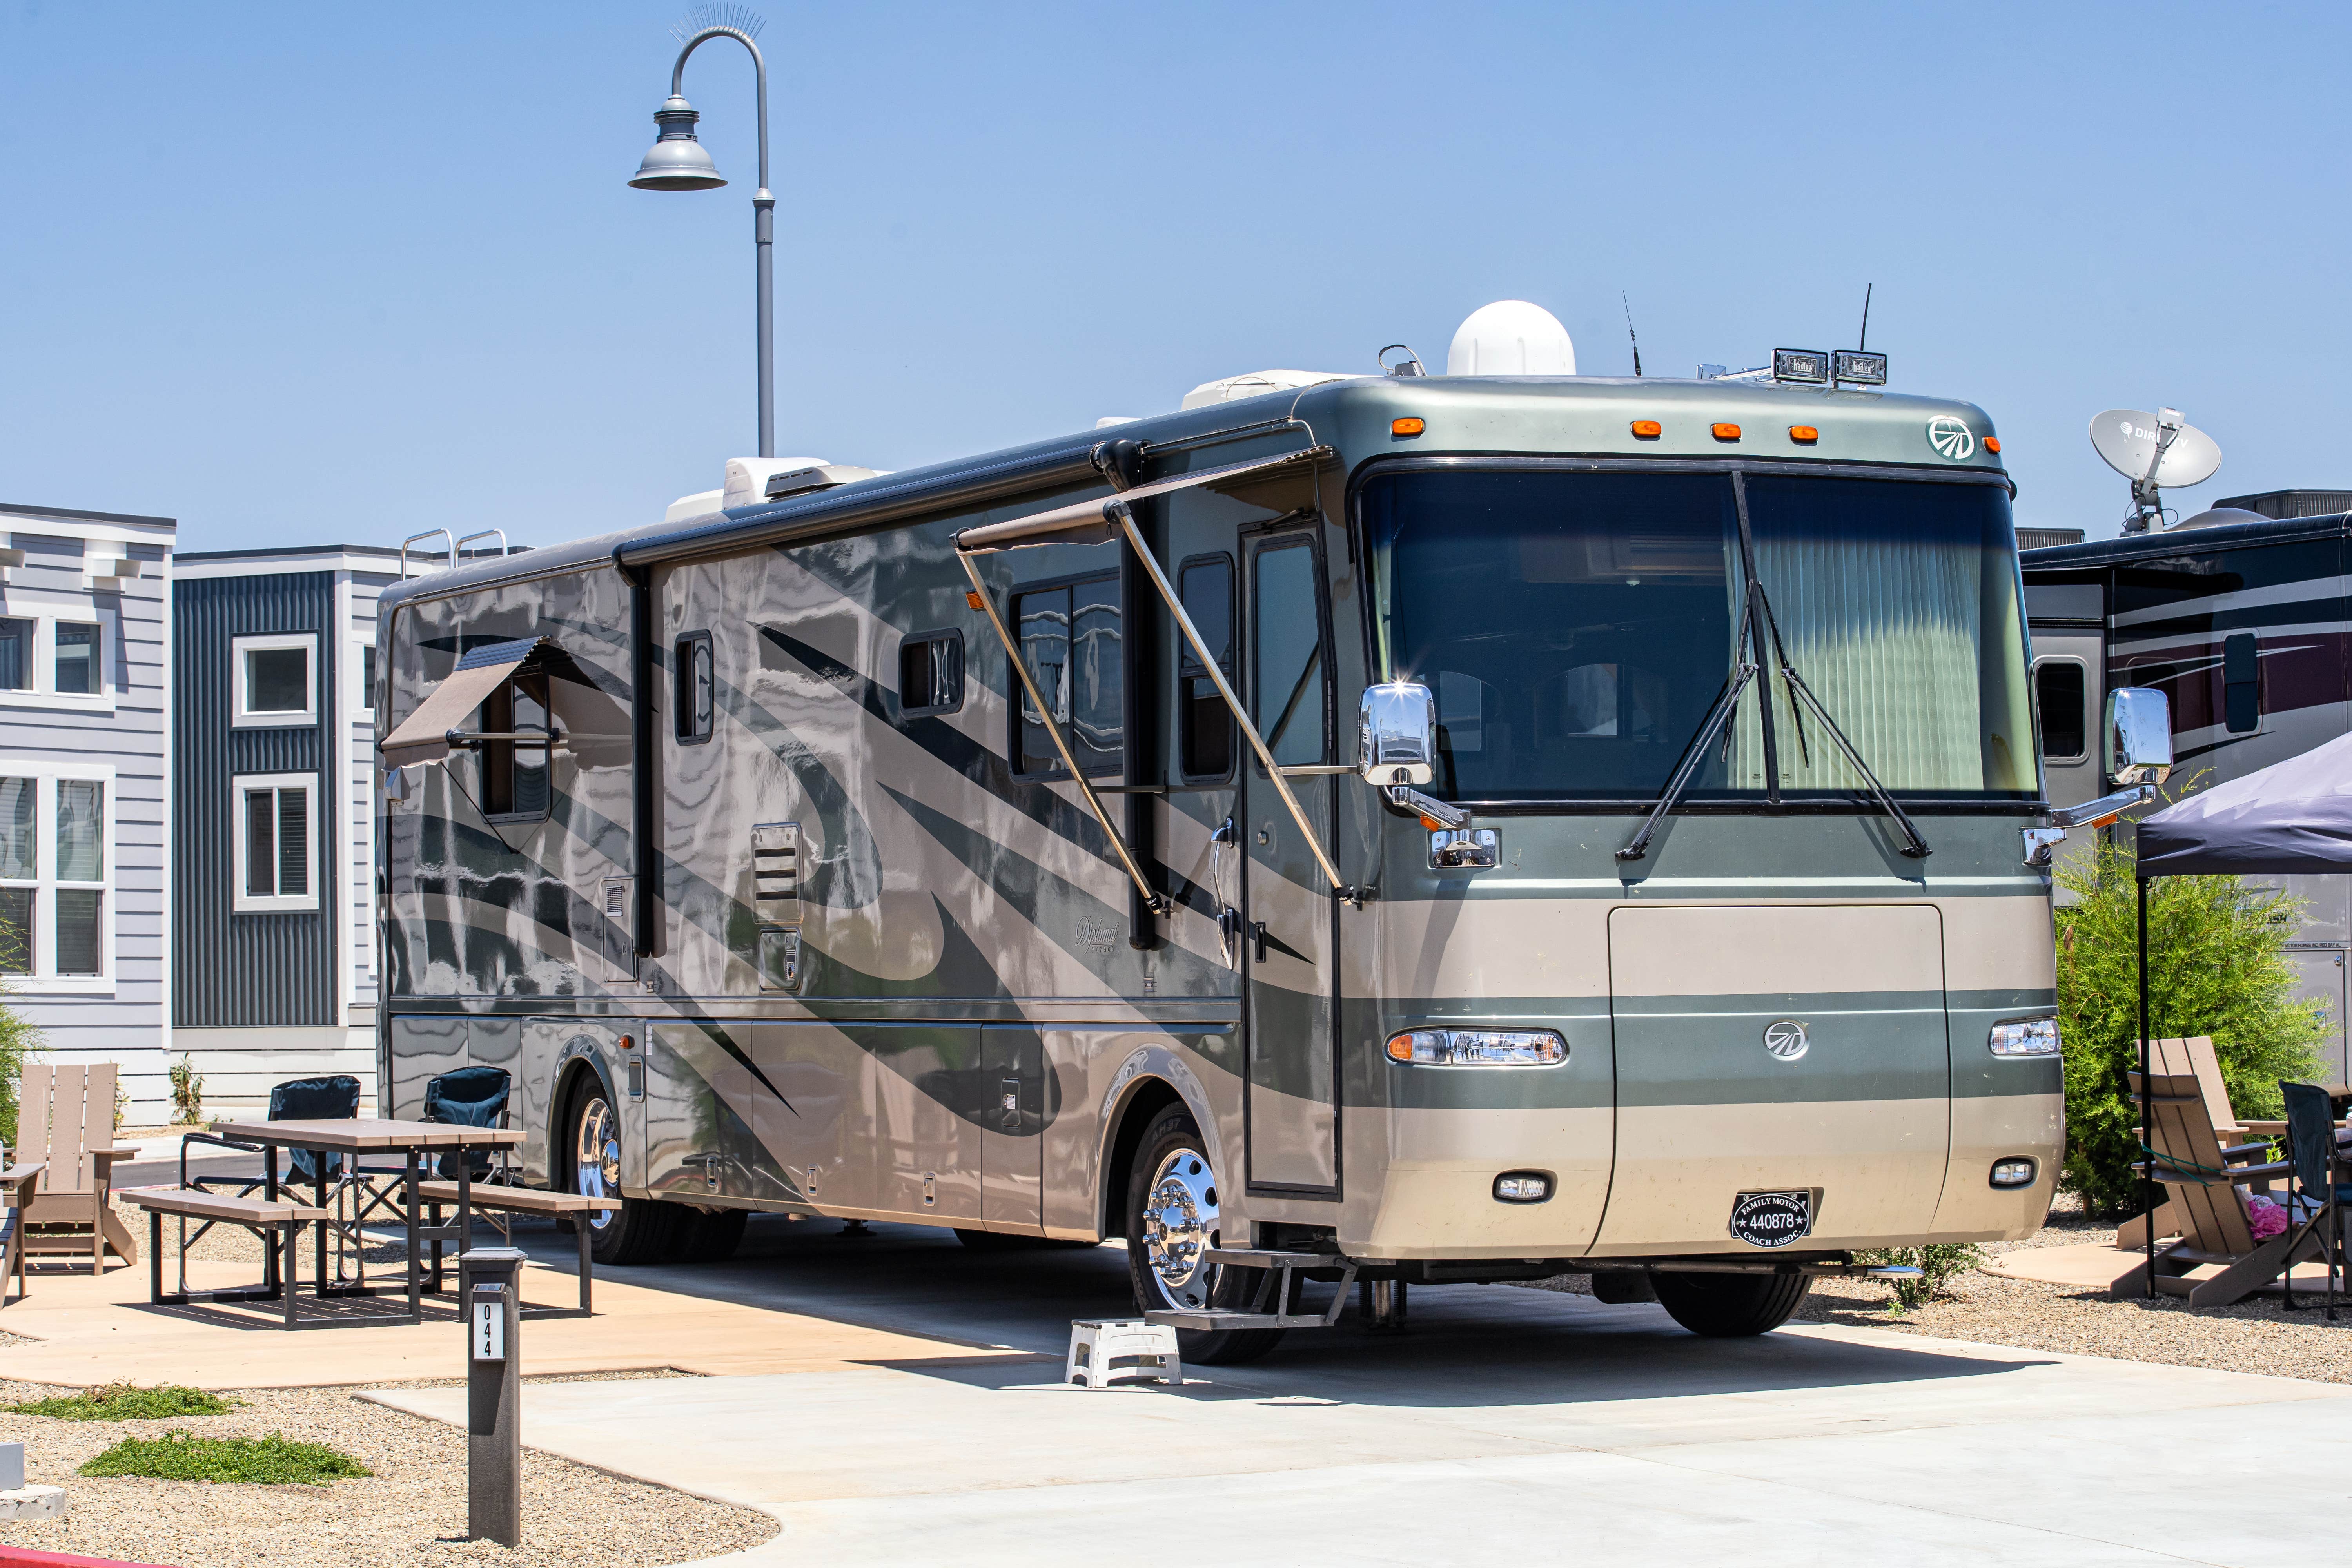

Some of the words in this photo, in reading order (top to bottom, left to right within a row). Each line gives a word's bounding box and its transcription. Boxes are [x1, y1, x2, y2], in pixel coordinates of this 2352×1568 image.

[1793, 359, 1813, 373] hadley
[1853, 361, 1874, 374] hadley
[2135, 428, 2189, 448] DIRTV
[1075, 916, 1119, 955] Diplomat
[1741, 1198, 1771, 1215] FAMILY
[1772, 1198, 1799, 1212] MOTOR
[1750, 1213, 1794, 1229] 440878
[1744, 1232, 1771, 1246] COACH
[1773, 1230, 1801, 1245] ASSOC.
